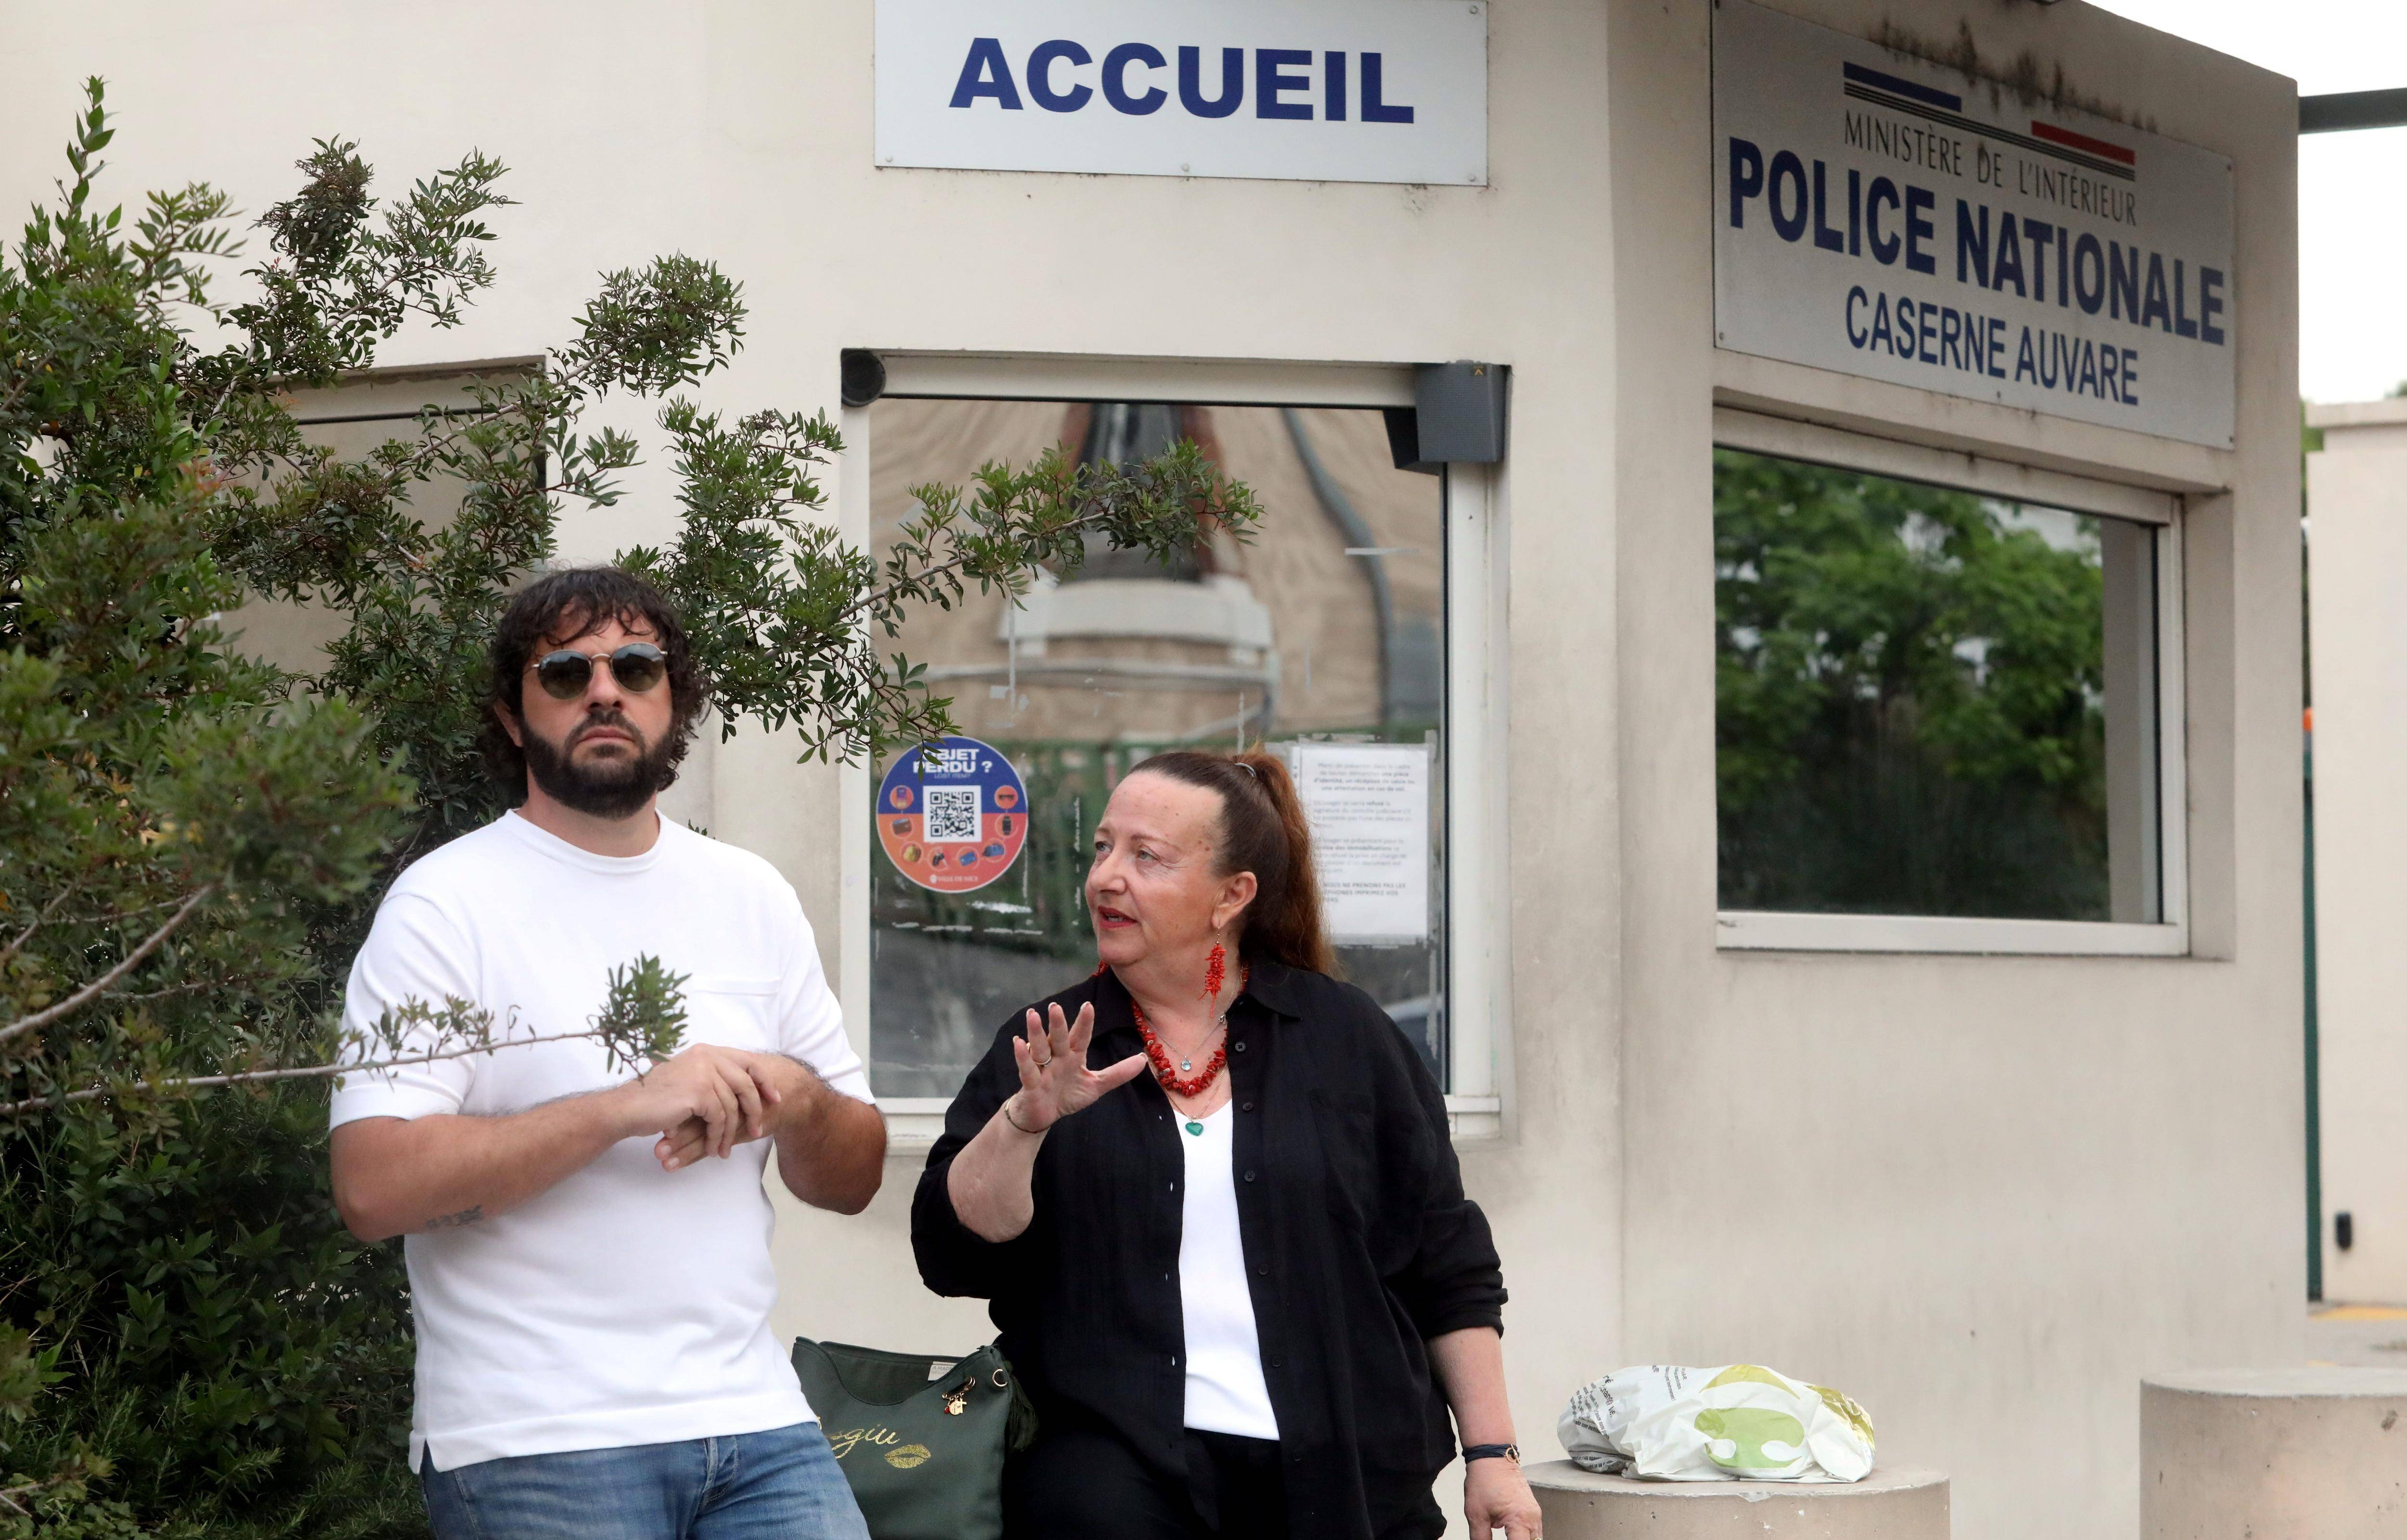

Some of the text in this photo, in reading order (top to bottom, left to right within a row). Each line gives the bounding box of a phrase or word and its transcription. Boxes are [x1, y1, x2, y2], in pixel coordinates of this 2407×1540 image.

[949, 37, 1414, 124] ACCUEIL
[1844, 109, 2136, 227] MINISTÈRE DE L'INTÉRIEUR
[1729, 136, 2225, 346] POLICE NATIONALE
[1846, 285, 2138, 406] CASERNE AUVARE
